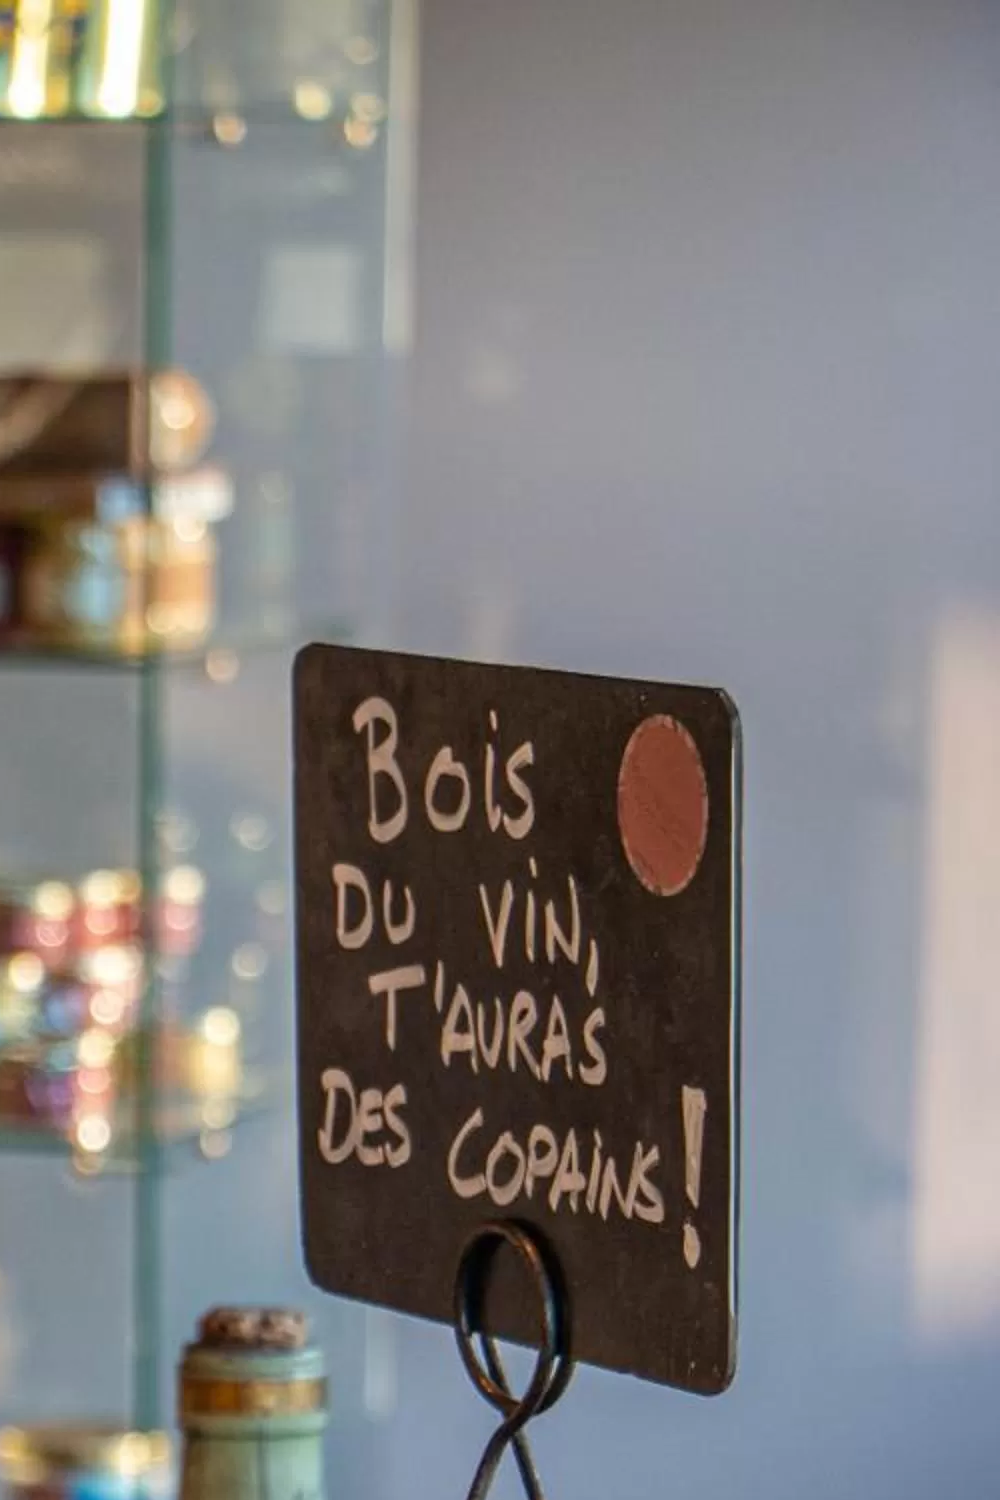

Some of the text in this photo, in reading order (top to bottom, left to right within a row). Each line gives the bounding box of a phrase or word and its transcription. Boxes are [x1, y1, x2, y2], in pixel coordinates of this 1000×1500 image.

[331, 863, 417, 951] DU
[368, 961, 608, 1087] T'AURAS
[317, 1068, 412, 1169] DES
